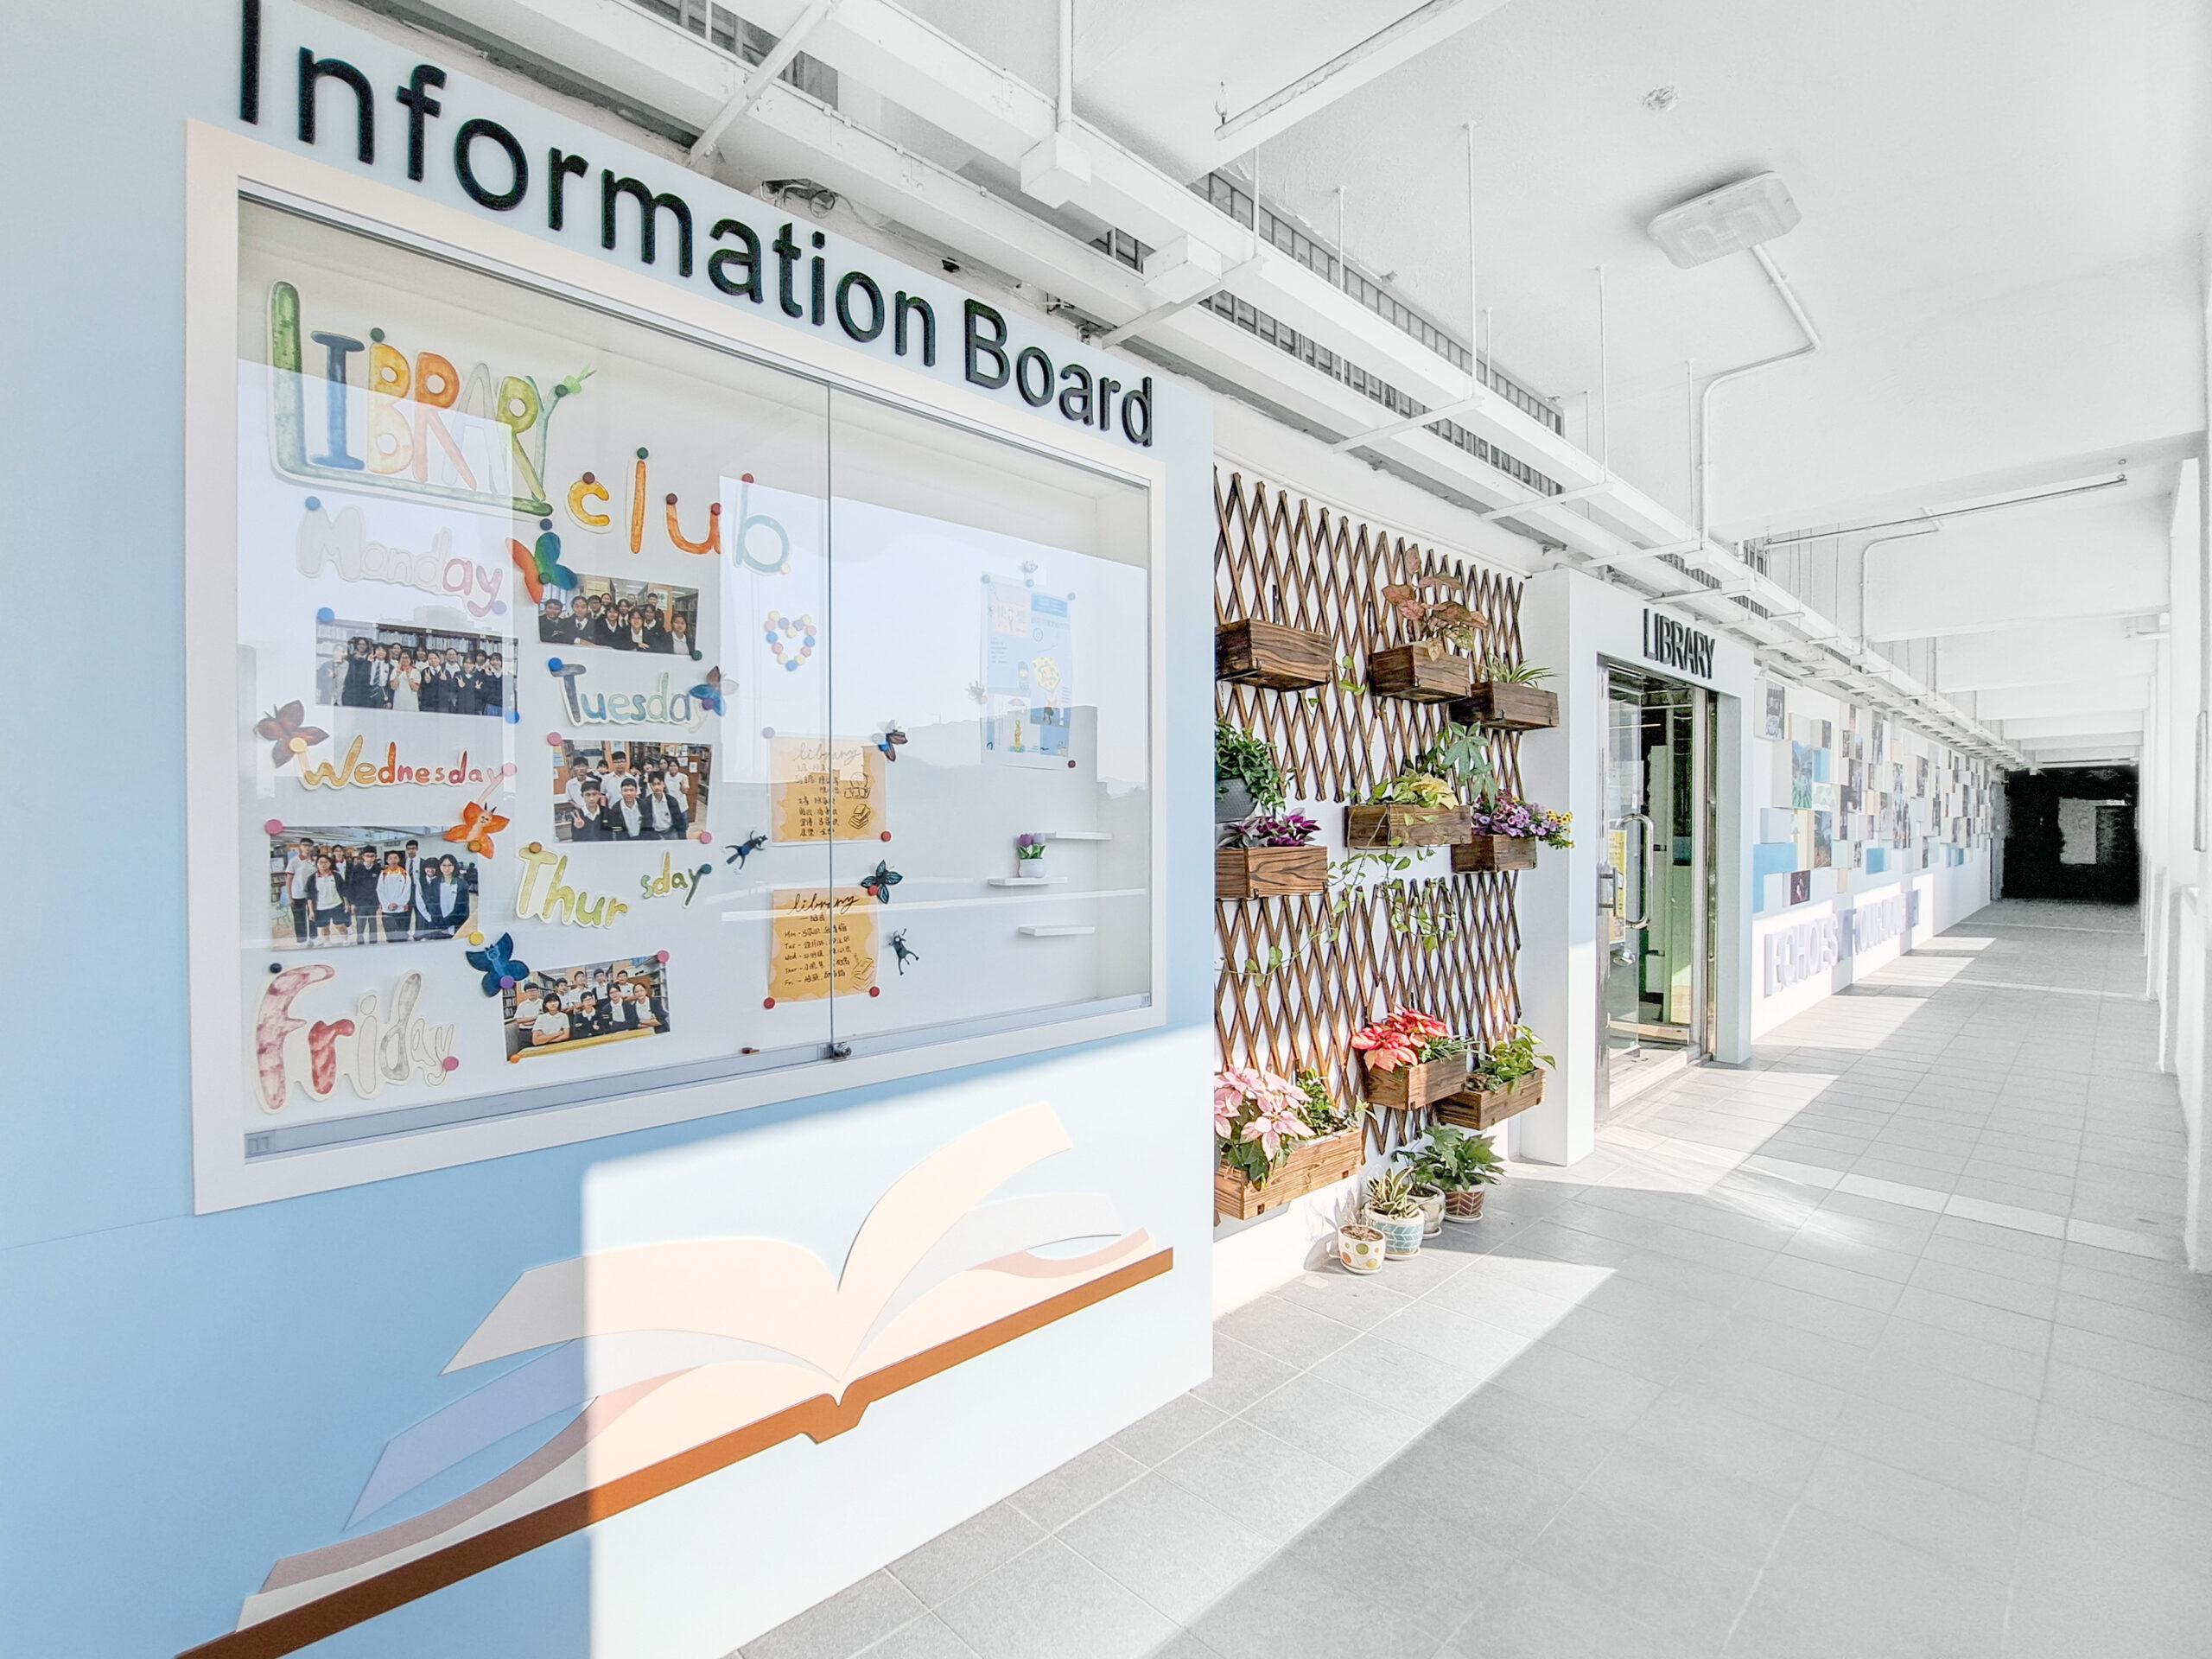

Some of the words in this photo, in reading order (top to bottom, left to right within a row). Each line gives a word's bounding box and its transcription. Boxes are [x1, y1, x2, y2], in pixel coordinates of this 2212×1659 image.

[239, 0, 936, 367] Information
[964, 298, 1154, 448] Board
[270, 280, 567, 518] LIBRARY
[296, 504, 505, 617] Monday
[567, 460, 791, 574] club
[1643, 608, 1716, 680] LIBRARY
[295, 735, 511, 804] Wednesday
[518, 846, 629, 928] Thur
[640, 852, 712, 907] sday
[788, 893, 861, 915] library
[1764, 913, 1839, 1000] ECHOES
[257, 963, 456, 1113] Friday
